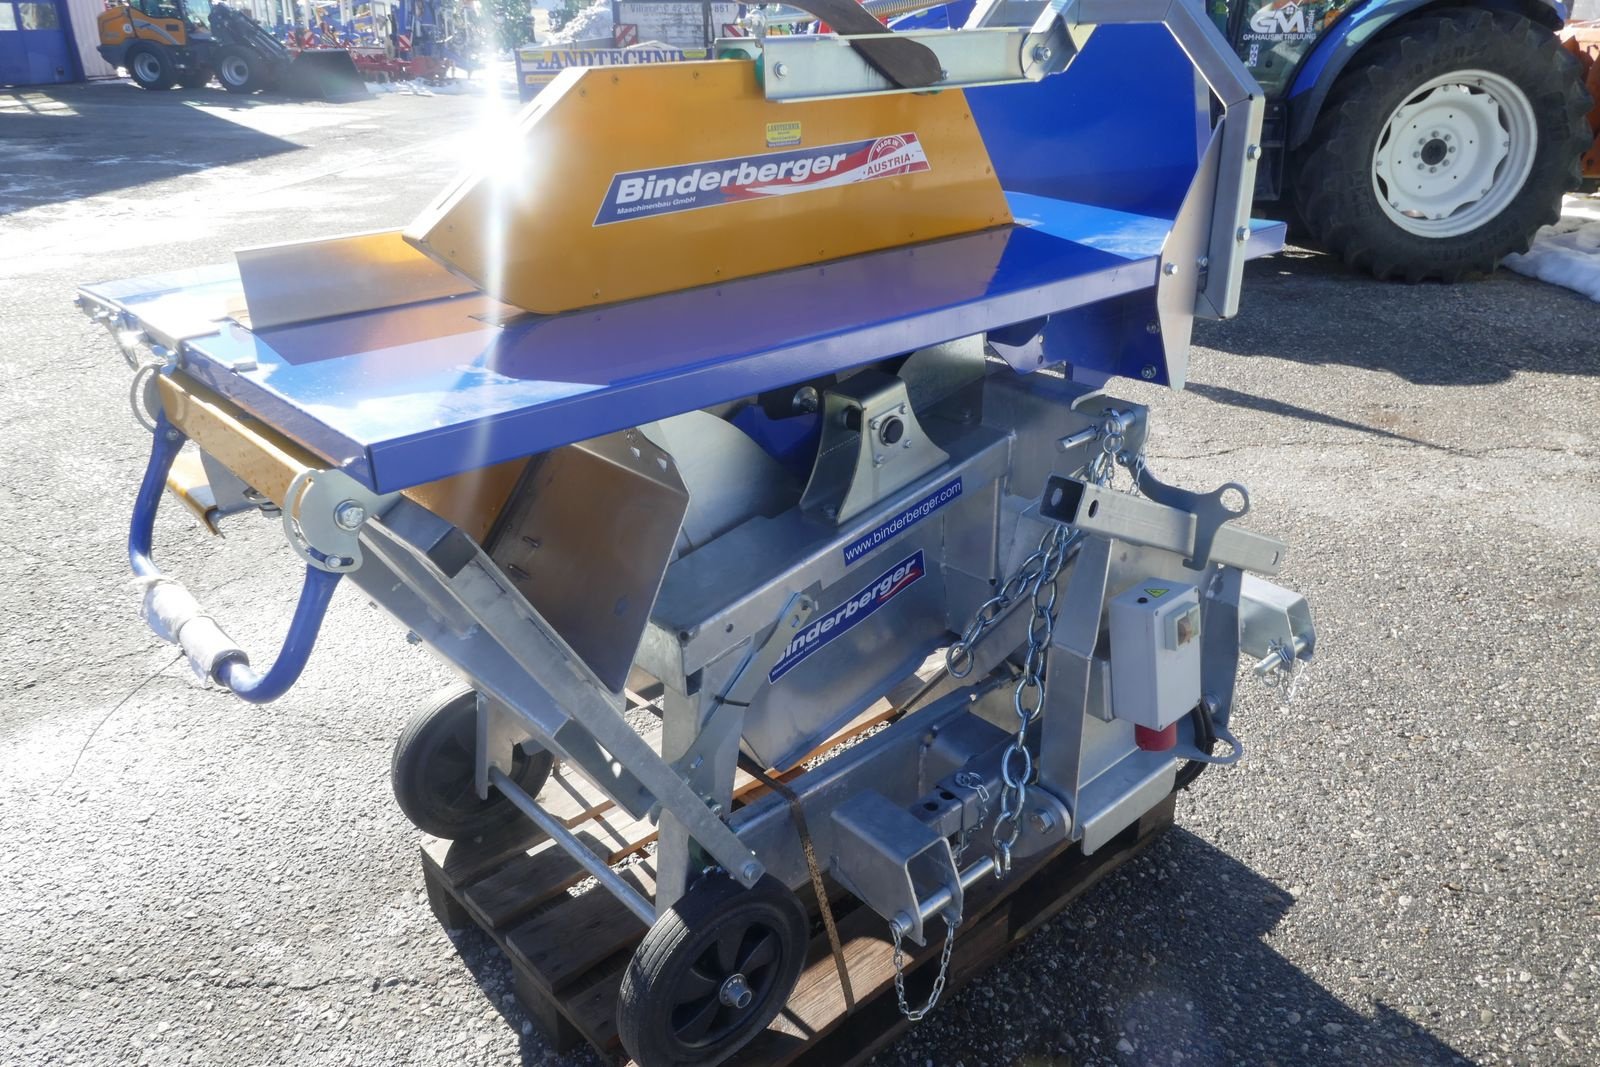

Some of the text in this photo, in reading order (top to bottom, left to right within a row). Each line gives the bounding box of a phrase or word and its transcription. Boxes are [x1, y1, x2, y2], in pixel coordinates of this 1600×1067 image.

[876, 138, 900, 153] MADE IN
[615, 153, 847, 205] Binderberger
[867, 153, 911, 176] AUSTRIA
[617, 196, 697, 215] Maschinenbau GmbH
[845, 482, 961, 561] www.binderberger.com
[774, 559, 916, 664] inderberger
